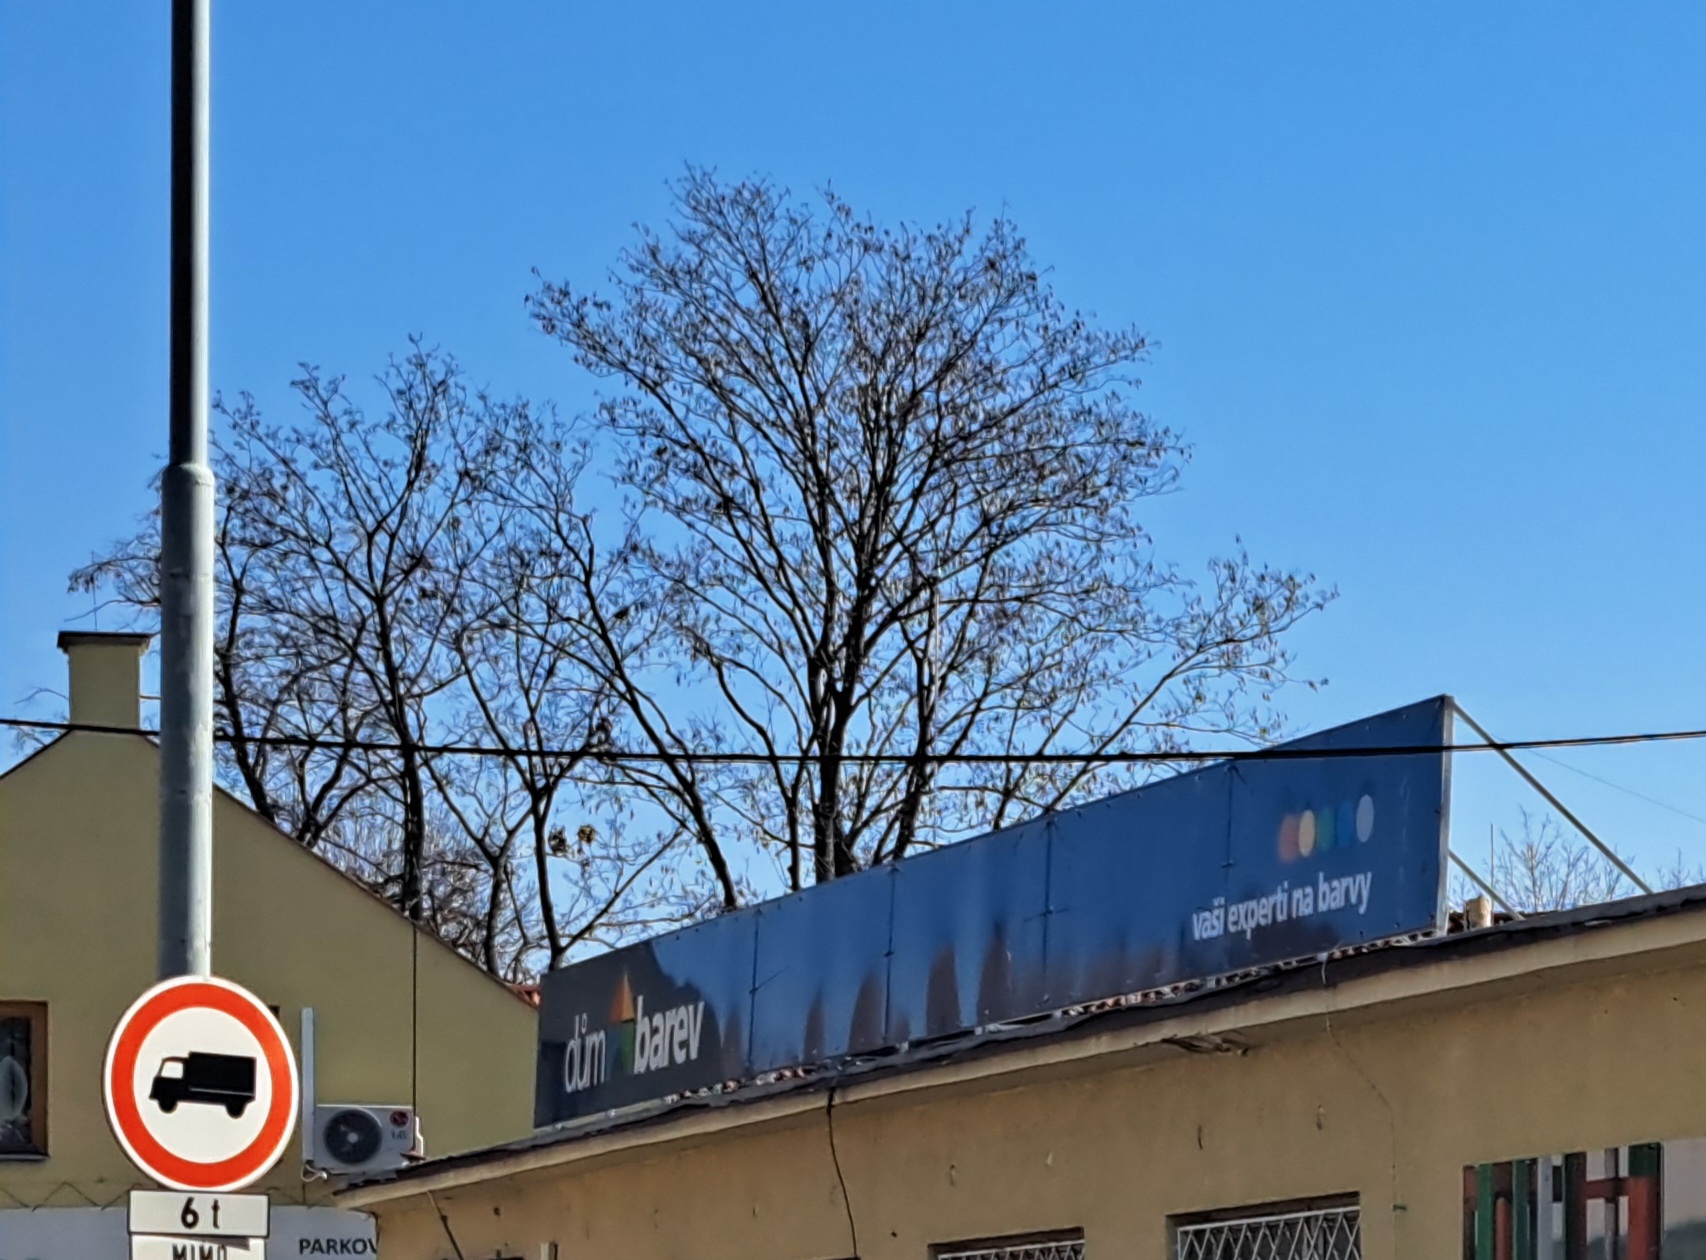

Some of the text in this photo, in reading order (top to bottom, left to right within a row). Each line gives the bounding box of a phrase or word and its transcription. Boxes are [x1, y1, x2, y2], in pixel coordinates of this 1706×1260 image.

[1192, 871, 1372, 940] vaši experti na barvy
[565, 994, 706, 1094] dům barev
[180, 1198, 221, 1229] 6 t
